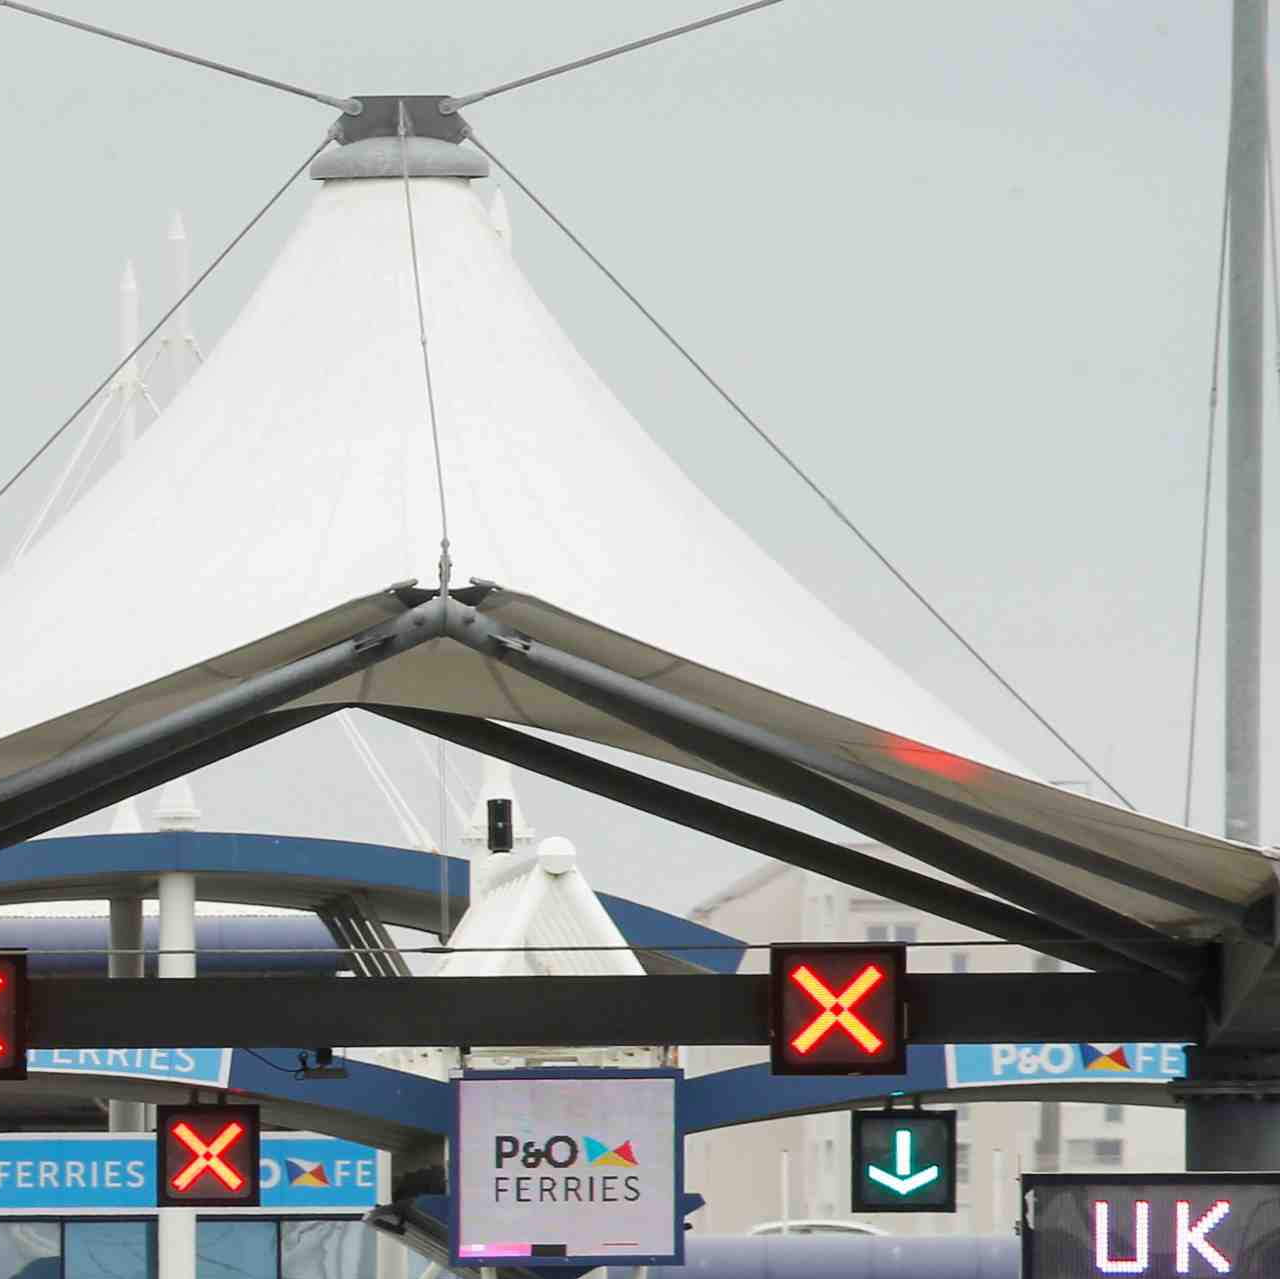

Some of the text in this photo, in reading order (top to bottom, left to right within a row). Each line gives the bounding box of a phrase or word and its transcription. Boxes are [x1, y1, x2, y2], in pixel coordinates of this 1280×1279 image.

[991, 1044, 1075, 1075] P&O
[495, 1135, 579, 1168] P&O
[495, 1175, 641, 1202] FERRIES
[1093, 1200, 1232, 1274] UK
